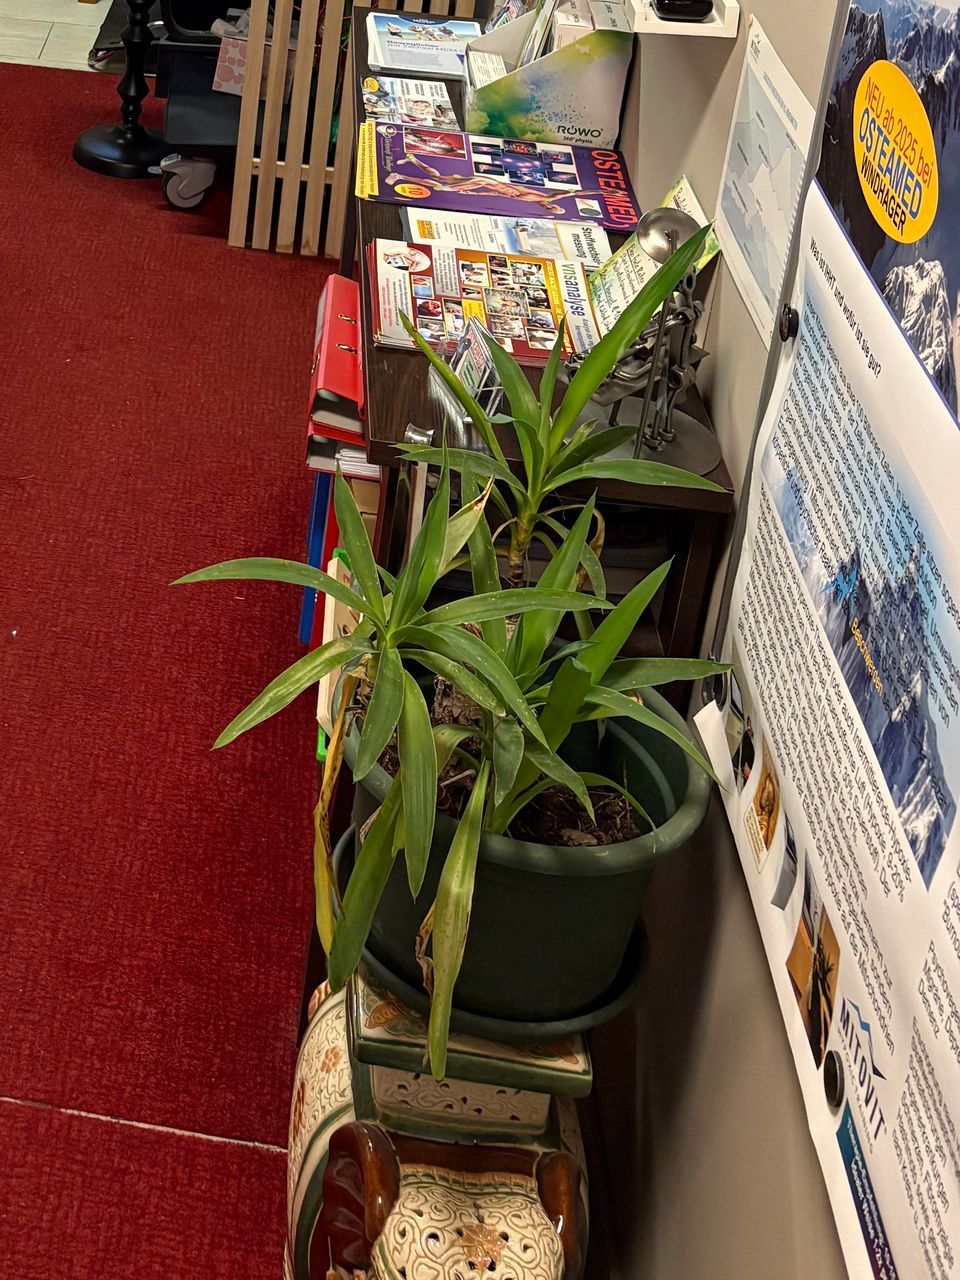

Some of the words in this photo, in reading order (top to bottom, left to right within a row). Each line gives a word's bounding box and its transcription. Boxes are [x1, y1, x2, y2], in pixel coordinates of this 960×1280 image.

[860, 107, 922, 220] OSTEAMED
[865, 77, 885, 118] NEU
[882, 108, 894, 135] ab
[893, 119, 916, 166] 2025
[916, 147, 933, 188] bei
[861, 152, 906, 236] WINDHAGER
[562, 263, 586, 317] vnsanalyse
[809, 237, 820, 258] Was
[833, 284, 843, 305] und
[842, 300, 856, 327] wofür
[867, 352, 880, 378] gut?
[850, 617, 884, 696] Beschwerden
[840, 998, 886, 1141] MITOVIT
